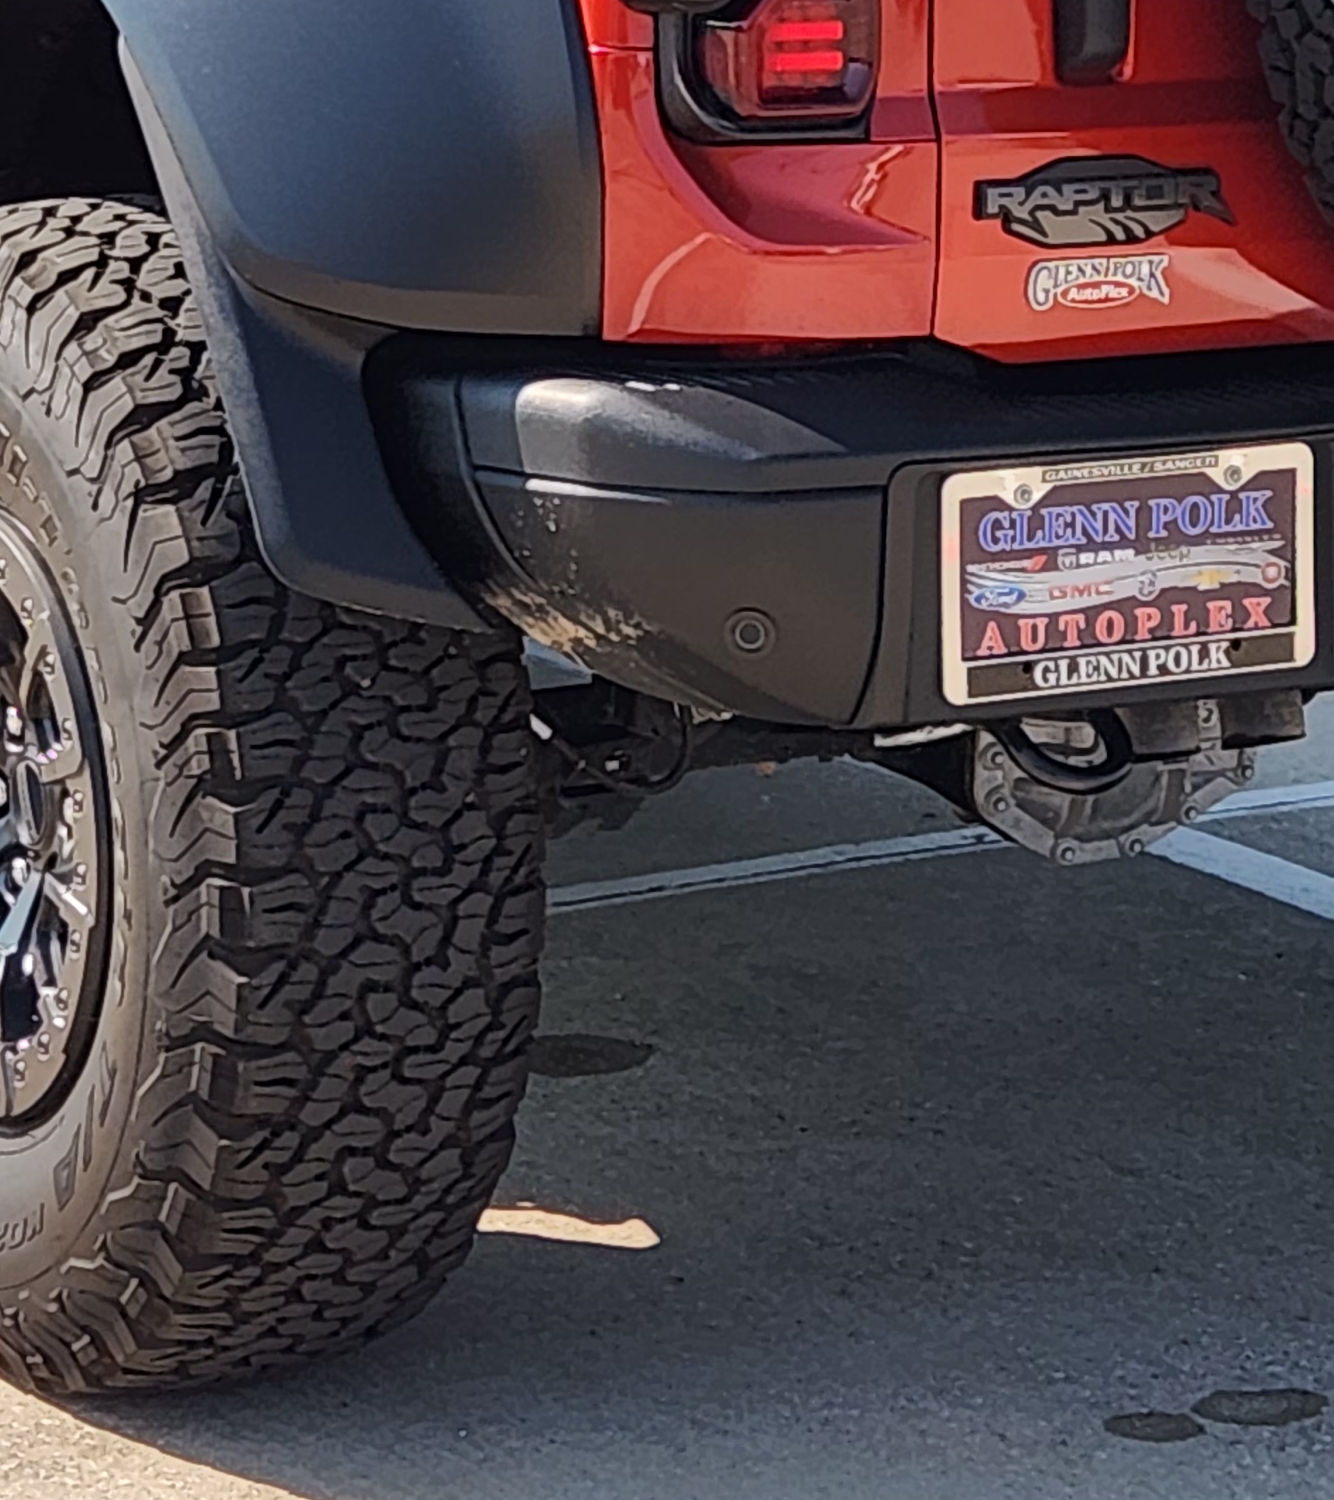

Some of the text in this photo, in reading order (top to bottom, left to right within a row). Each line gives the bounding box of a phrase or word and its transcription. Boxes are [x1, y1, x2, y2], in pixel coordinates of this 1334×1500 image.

[980, 170, 1238, 230] RAPTOR
[1029, 254, 1167, 308] GLENN POLK
[978, 489, 1273, 553] GLENN POLK
[1078, 548, 1136, 564] RAM
[1048, 581, 1117, 600] GMC
[975, 596, 1273, 657] AUTOPLEX
[1033, 640, 1232, 689] GLENN POLK
